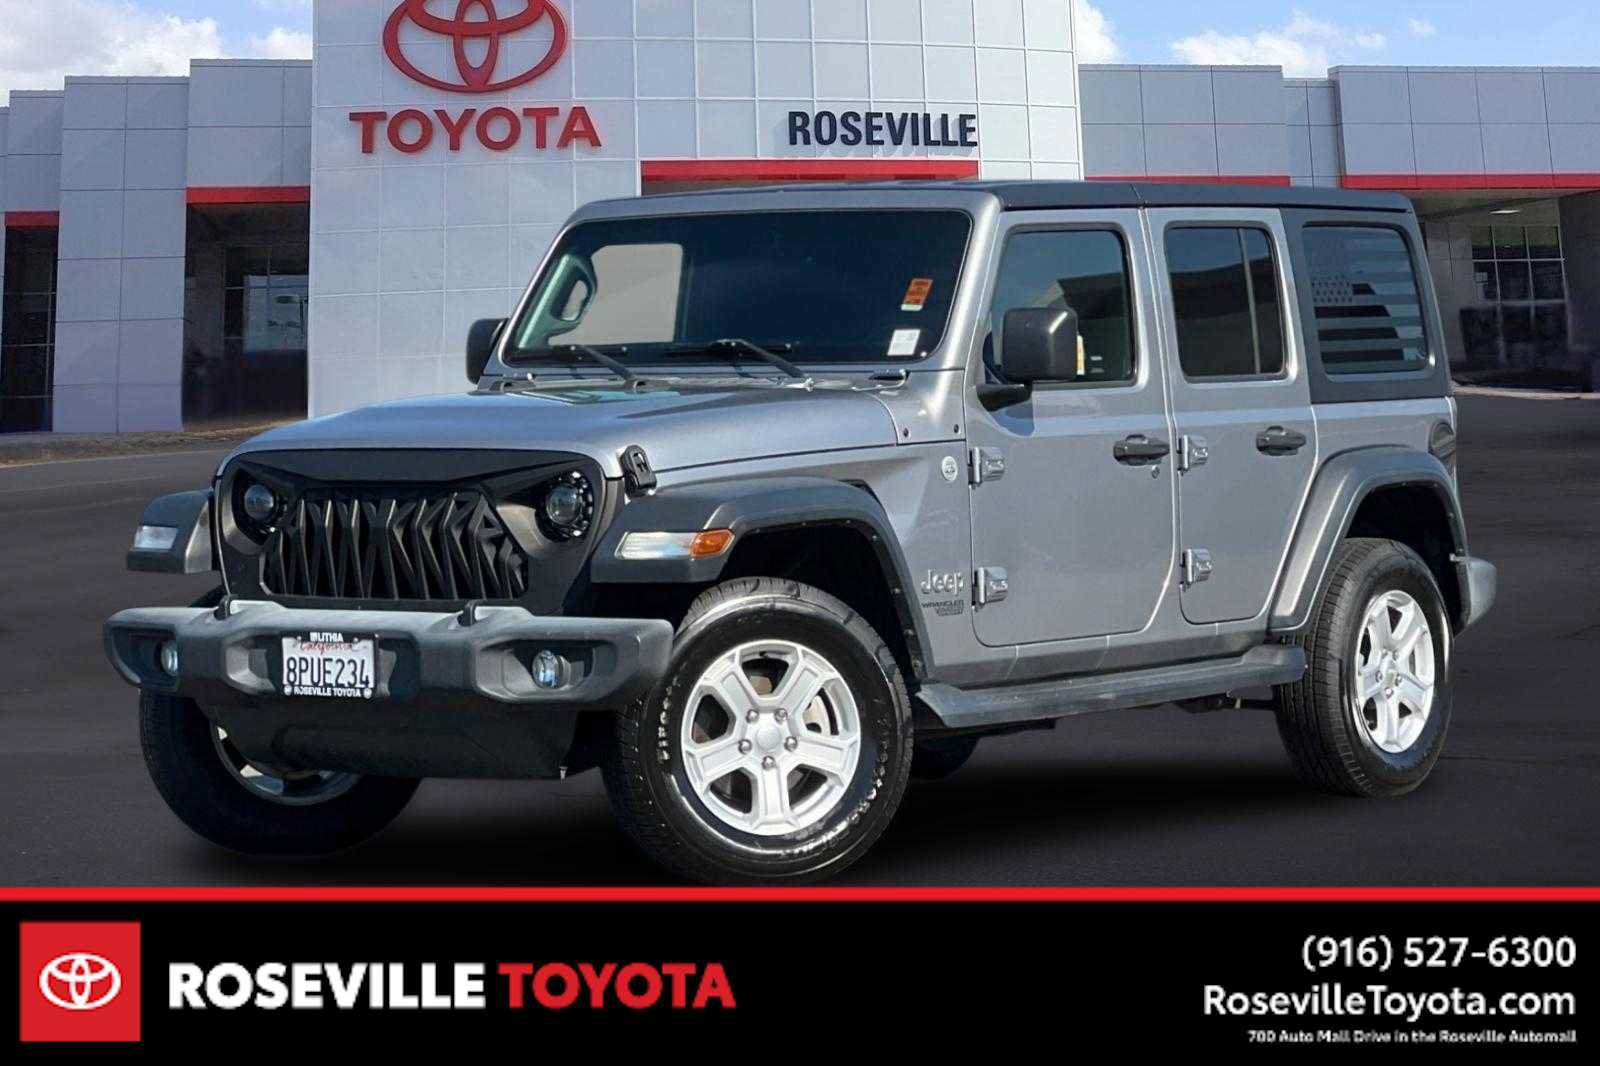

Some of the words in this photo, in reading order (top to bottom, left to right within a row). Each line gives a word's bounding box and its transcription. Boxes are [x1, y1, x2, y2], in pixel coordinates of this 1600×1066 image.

[350, 106, 602, 154] TOYOTA
[788, 110, 978, 147] ROSEVILLE
[921, 569, 964, 597] Jeep
[286, 656, 370, 688] 8PUE234
[294, 686, 332, 697] ROSEVILLE
[333, 687, 362, 698] TOYOTA
